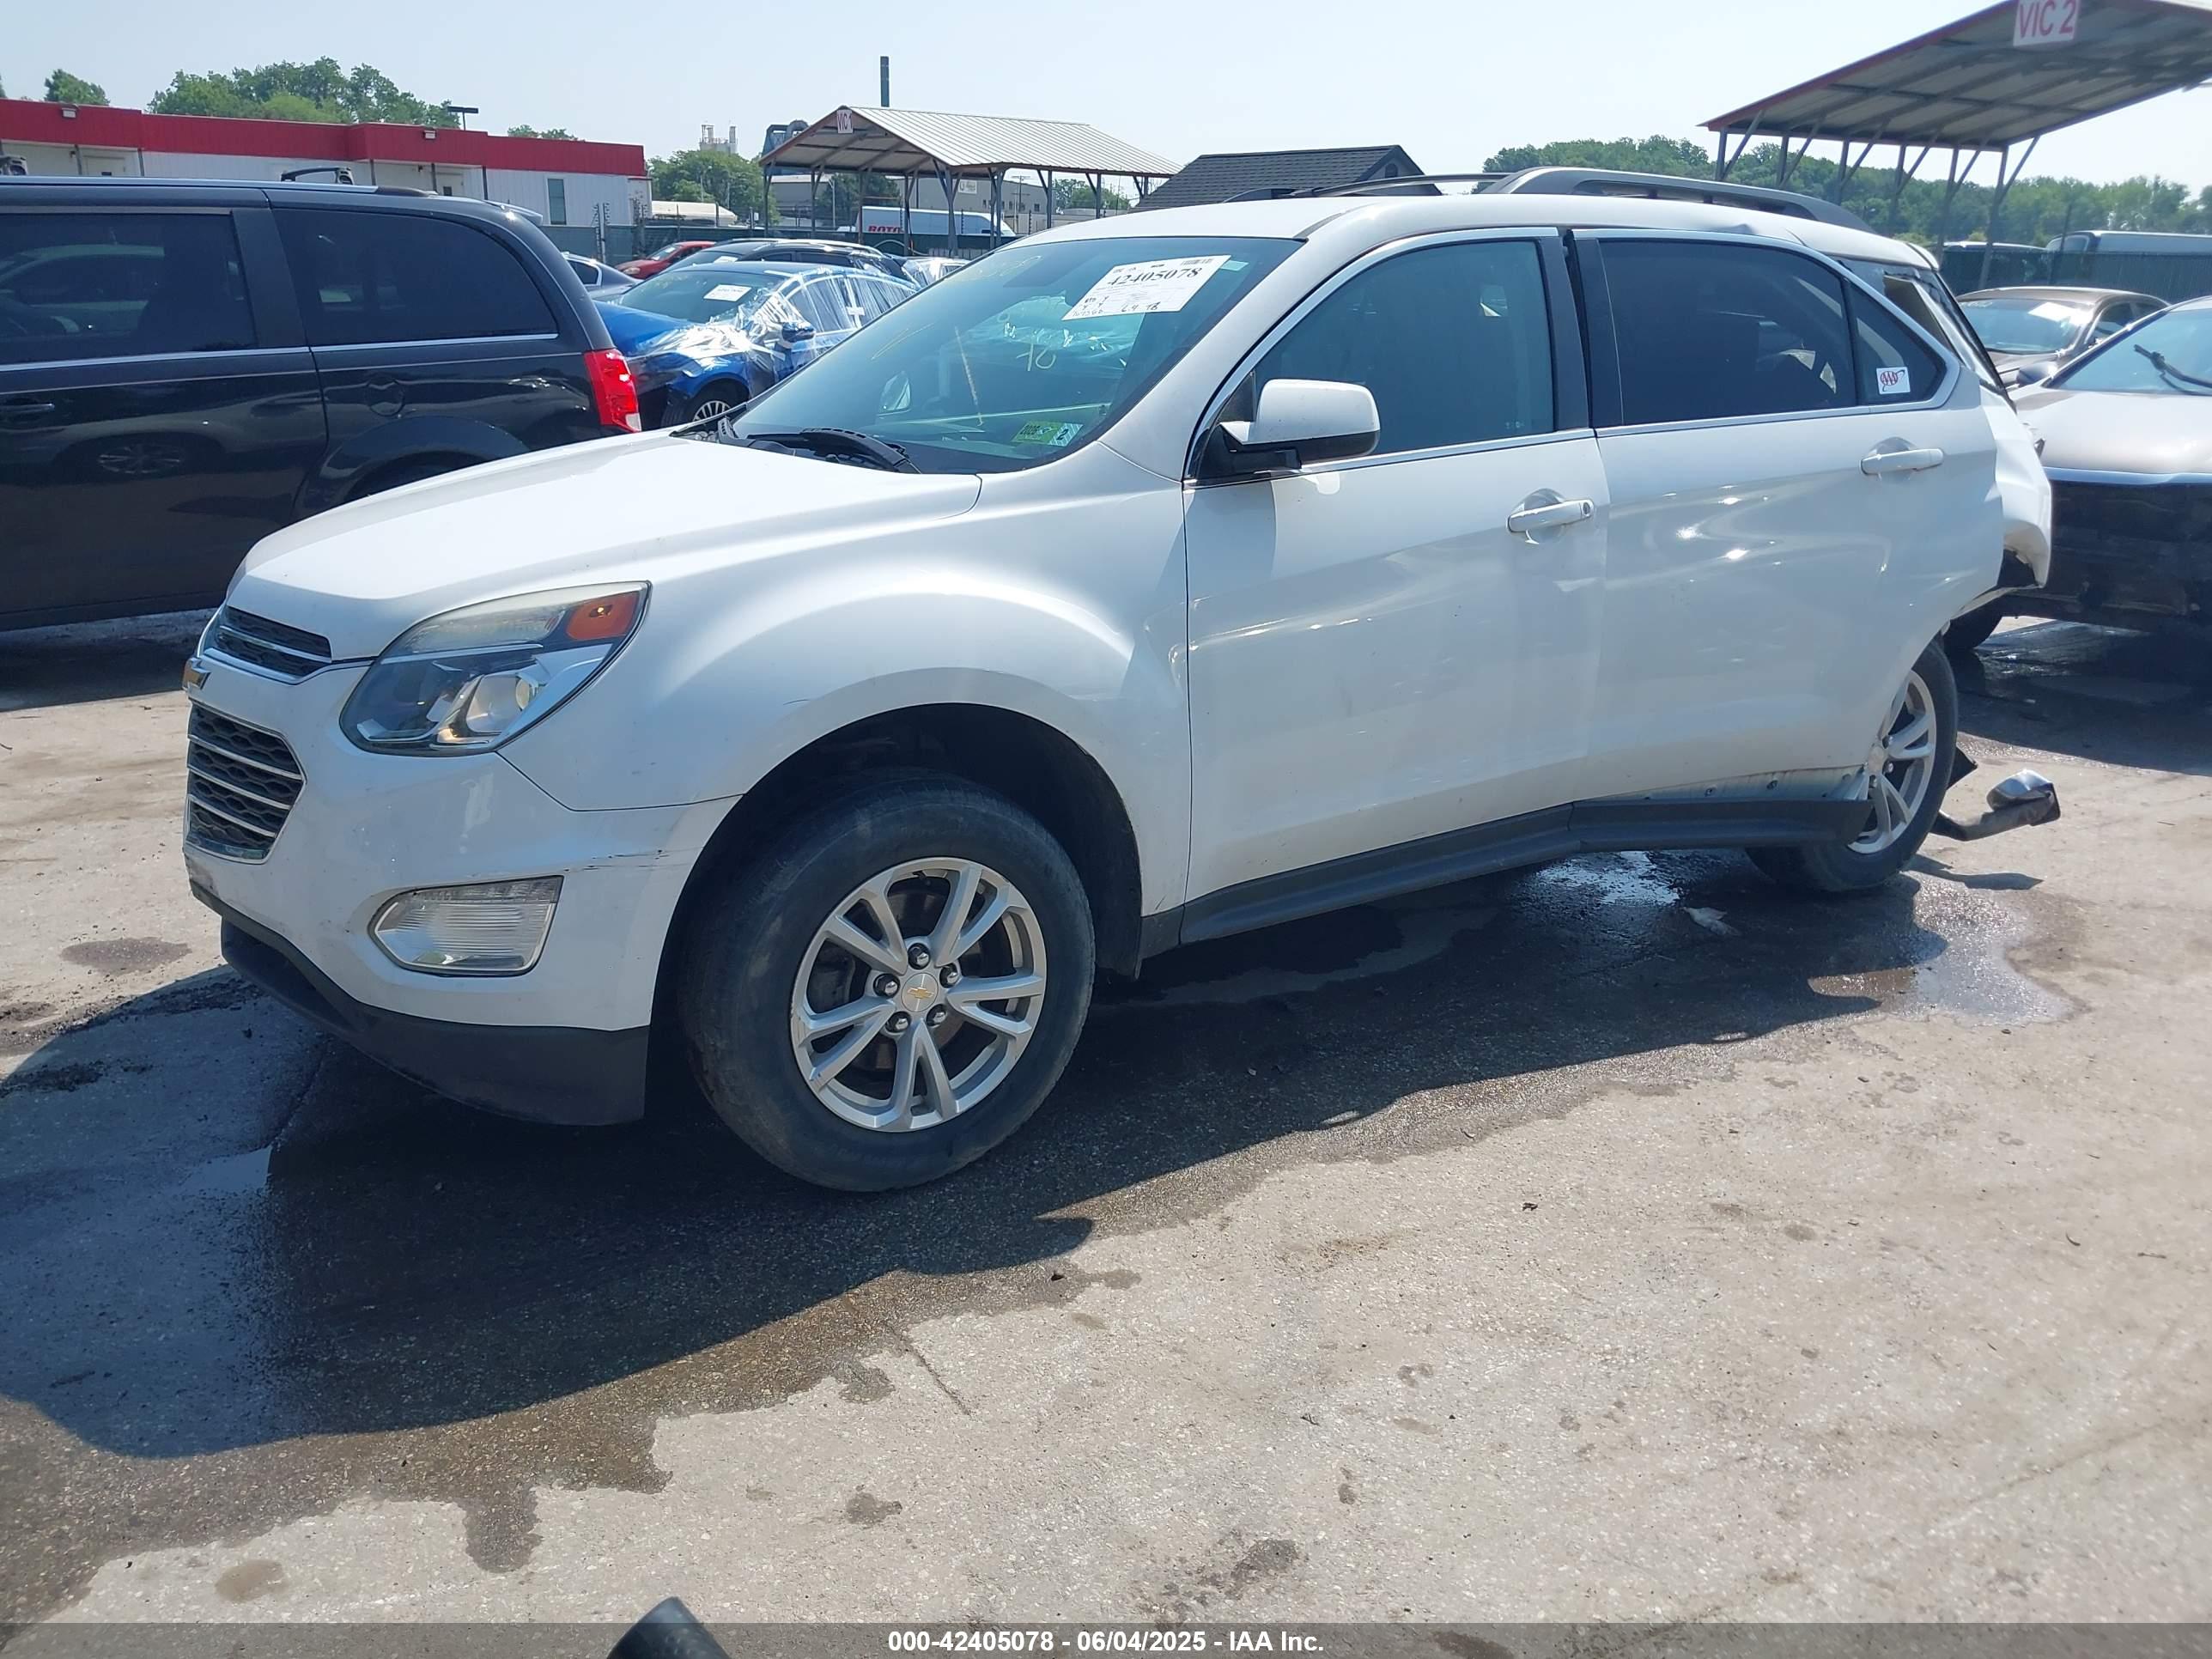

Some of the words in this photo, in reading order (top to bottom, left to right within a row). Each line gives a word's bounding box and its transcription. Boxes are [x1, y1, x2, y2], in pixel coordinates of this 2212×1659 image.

[2018, 0, 2057, 39] VIC
[2058, 0, 2076, 34] 2
[1108, 267, 1202, 285] 42405078
[1881, 370, 1898, 386] AAA
[1056, 429, 1069, 441] 2
